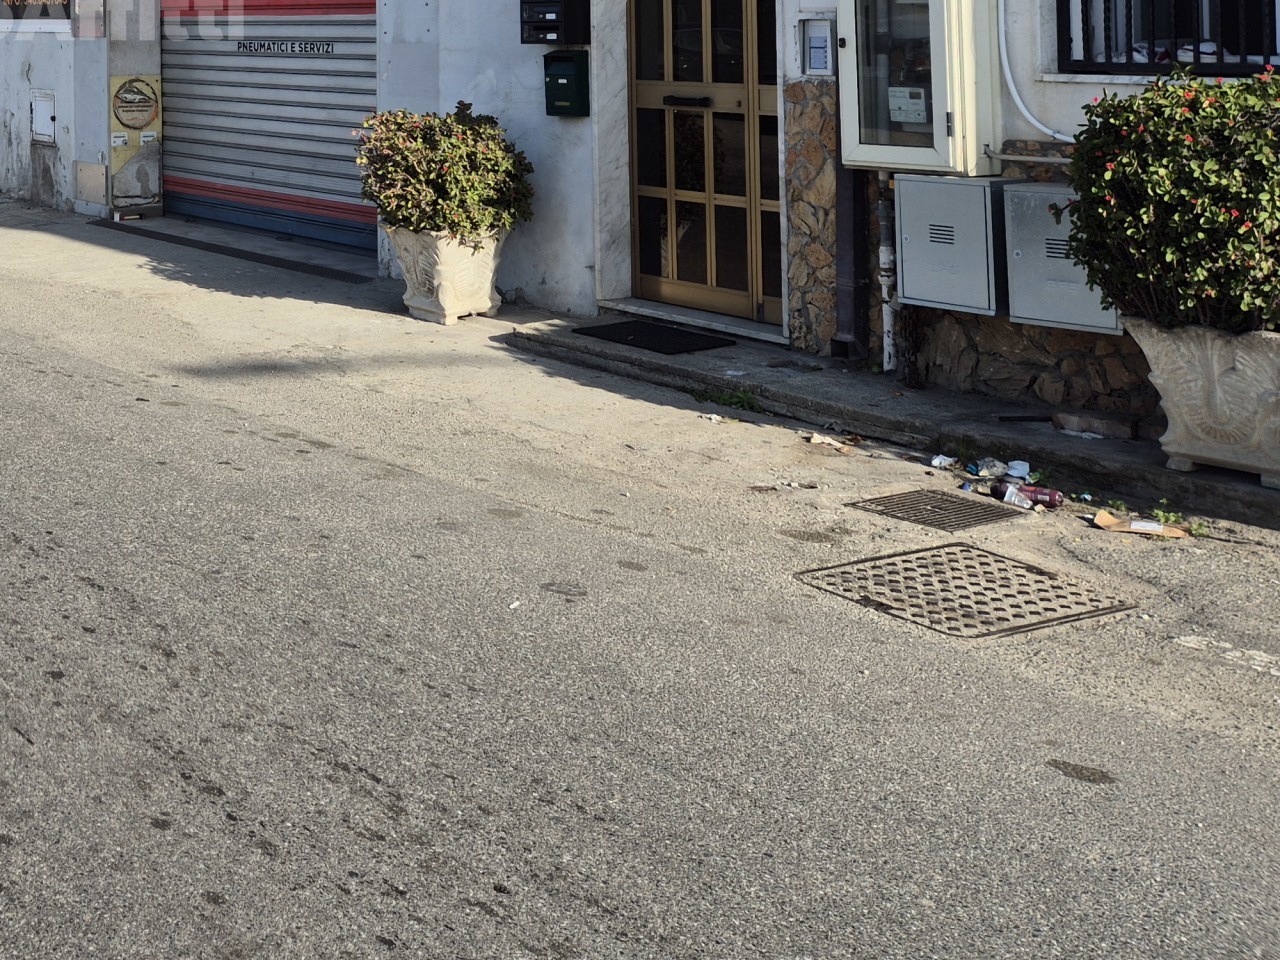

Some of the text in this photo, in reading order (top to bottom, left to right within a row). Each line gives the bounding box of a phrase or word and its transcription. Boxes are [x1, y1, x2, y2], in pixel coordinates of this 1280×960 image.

[237, 41, 334, 54] PNEUMATICI E SERVIZI
